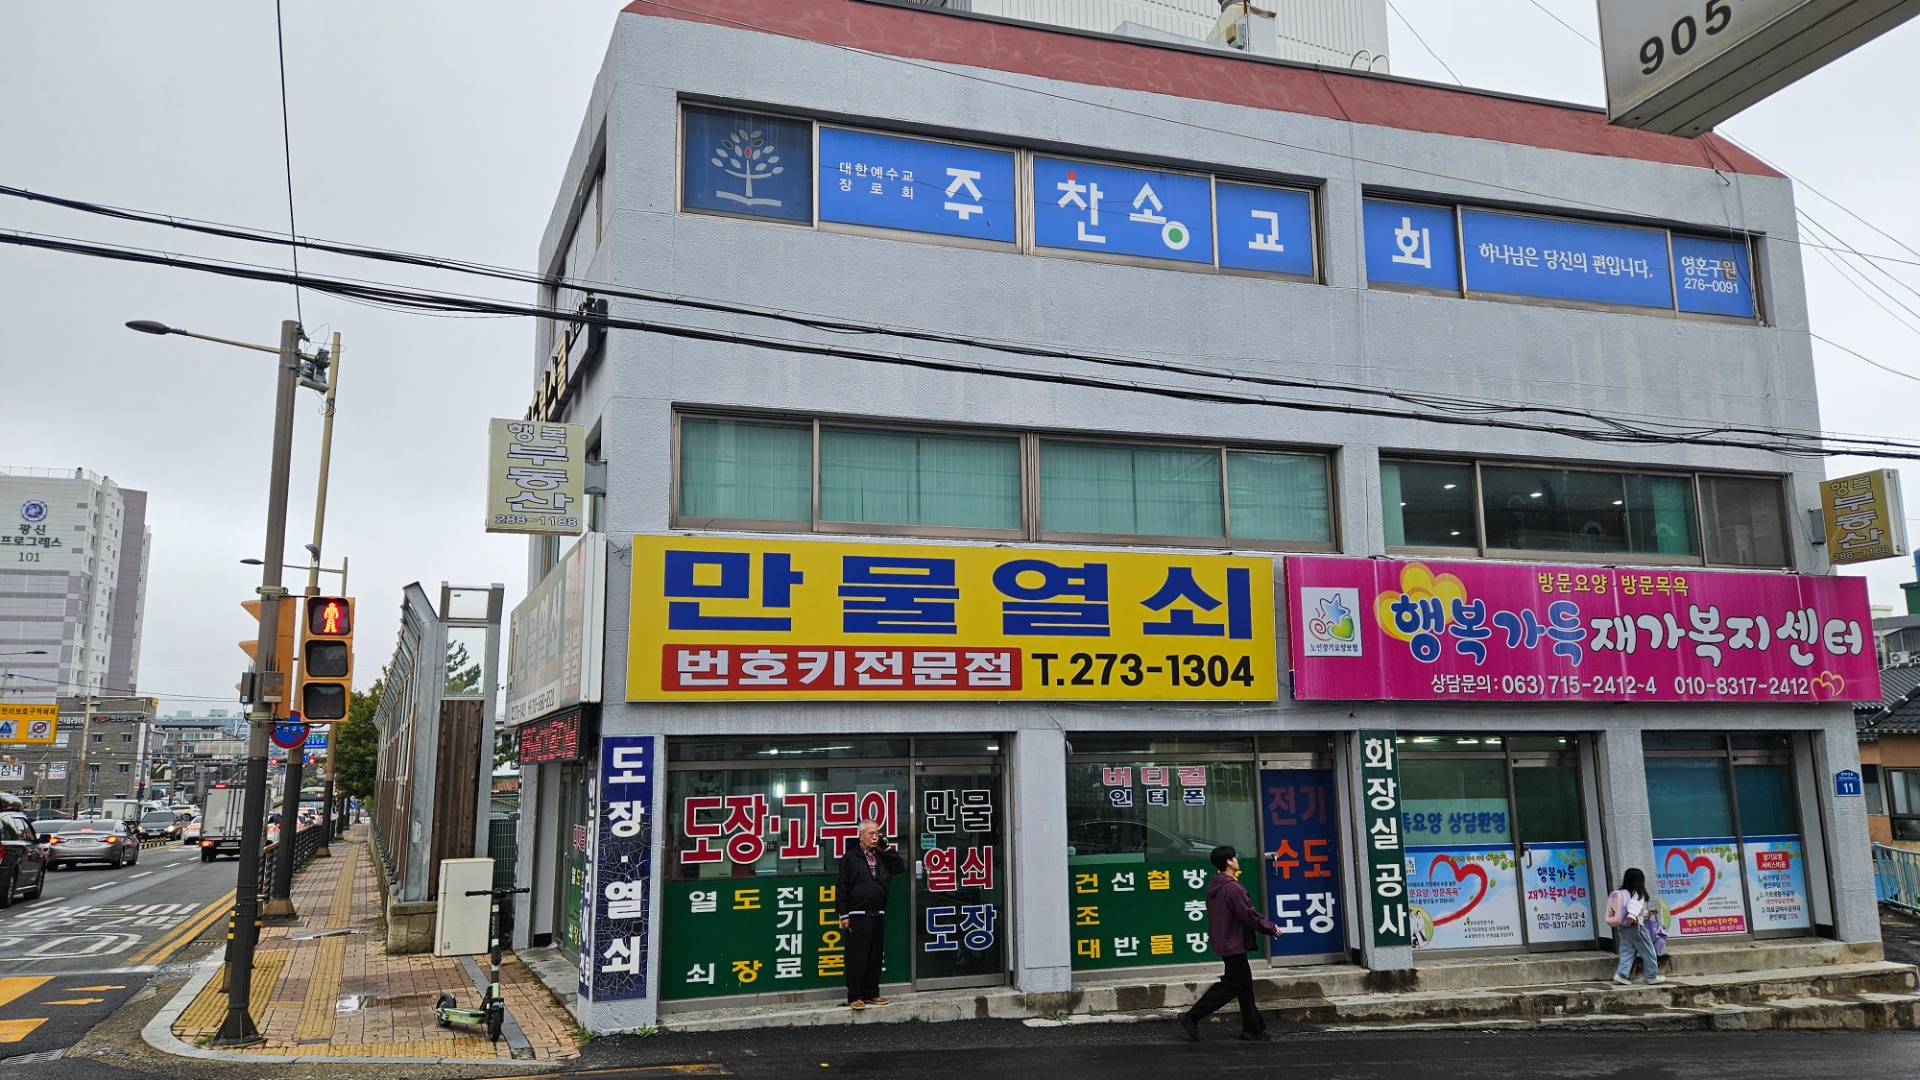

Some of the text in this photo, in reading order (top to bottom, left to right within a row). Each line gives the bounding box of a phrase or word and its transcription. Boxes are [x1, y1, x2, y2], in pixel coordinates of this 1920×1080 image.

[839, 161, 914, 183] 대한예수교
[1479, 243, 1653, 279] 하나님은 당신의 편입니다.
[1680, 255, 1737, 280] 영혼구원
[1684, 277, 1739, 294] 276-0091
[507, 423, 567, 445] 행복
[506, 443, 574, 514] 부동산
[1830, 476, 1871, 496] 행복
[18, 524, 47, 536] 광신
[495, 514, 578, 527] 288-1188
[1833, 491, 1884, 549] 부동산
[0, 536, 62, 548] 프로그레스
[1834, 546, 1889, 560] 288-1188
[18, 552, 40, 562] 101
[663, 549, 1254, 640] 만물열쇠
[1310, 643, 1359, 652] 노인장기요양보험
[677, 649, 1254, 688] 번호키전문점 T.273-1304
[1673, 676, 1808, 697] 010-8317-2412
[1102, 765, 1207, 788] 버티컬
[1843, 782, 1854, 793] 11
[1109, 788, 1206, 808] 인터폰
[1268, 786, 1327, 825] 전기
[924, 789, 993, 834] 만물
[1448, 811, 1506, 833] 상담환영
[923, 845, 993, 892] 열쇠
[1275, 839, 1332, 879] 수도
[1276, 892, 1335, 934] 도장
[925, 903, 997, 952] 도장
[1539, 921, 1586, 929] 010-8317-2412
